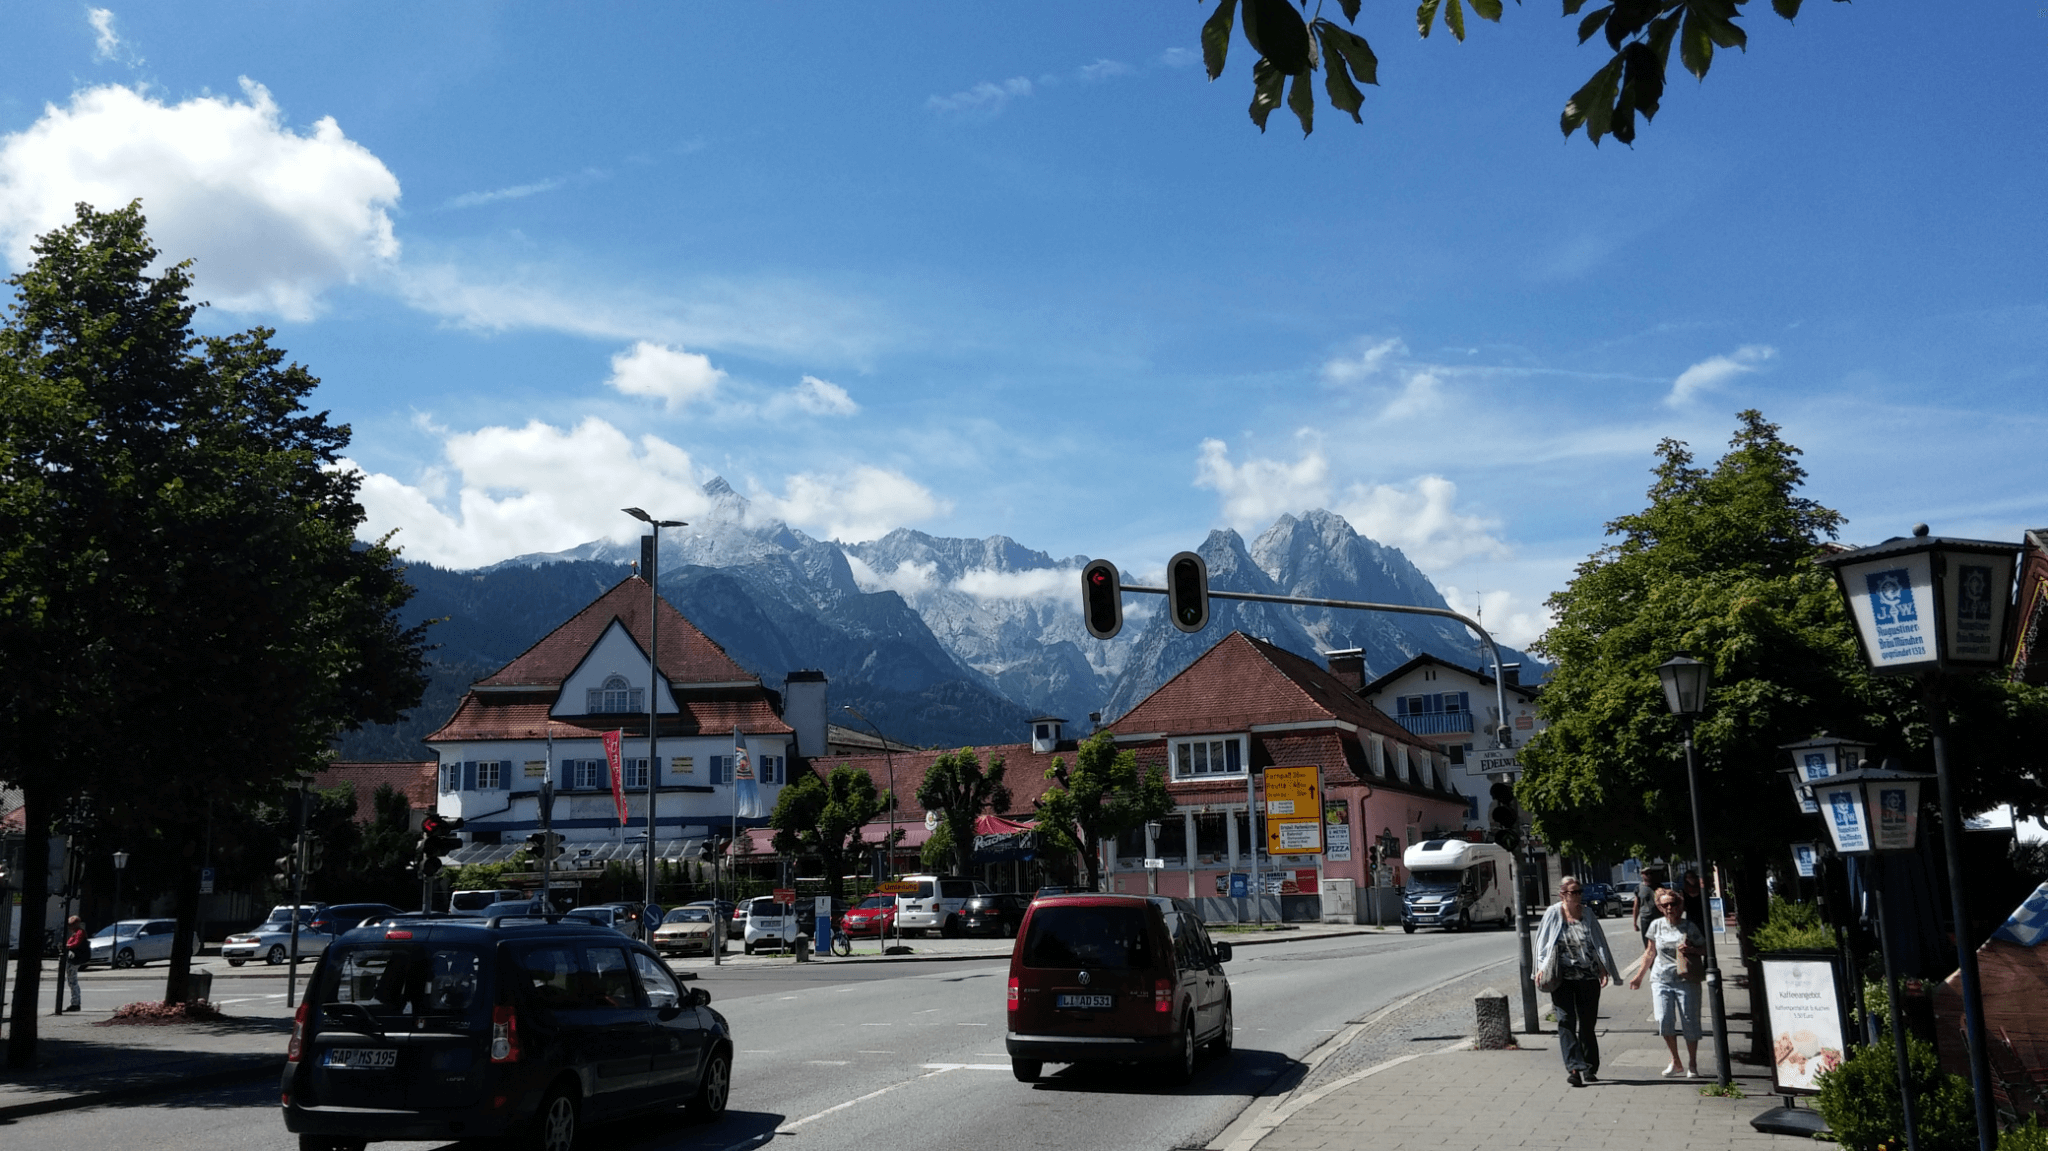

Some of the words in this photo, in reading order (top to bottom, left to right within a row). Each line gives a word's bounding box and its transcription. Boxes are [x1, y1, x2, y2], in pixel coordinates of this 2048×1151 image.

[1063, 996, 1074, 1006] LI
[1079, 996, 1092, 1006] AD
[1093, 996, 1111, 1006] 531
[331, 1050, 352, 1065] GAP
[357, 1051, 372, 1065] MS
[374, 1051, 396, 1066] 195
